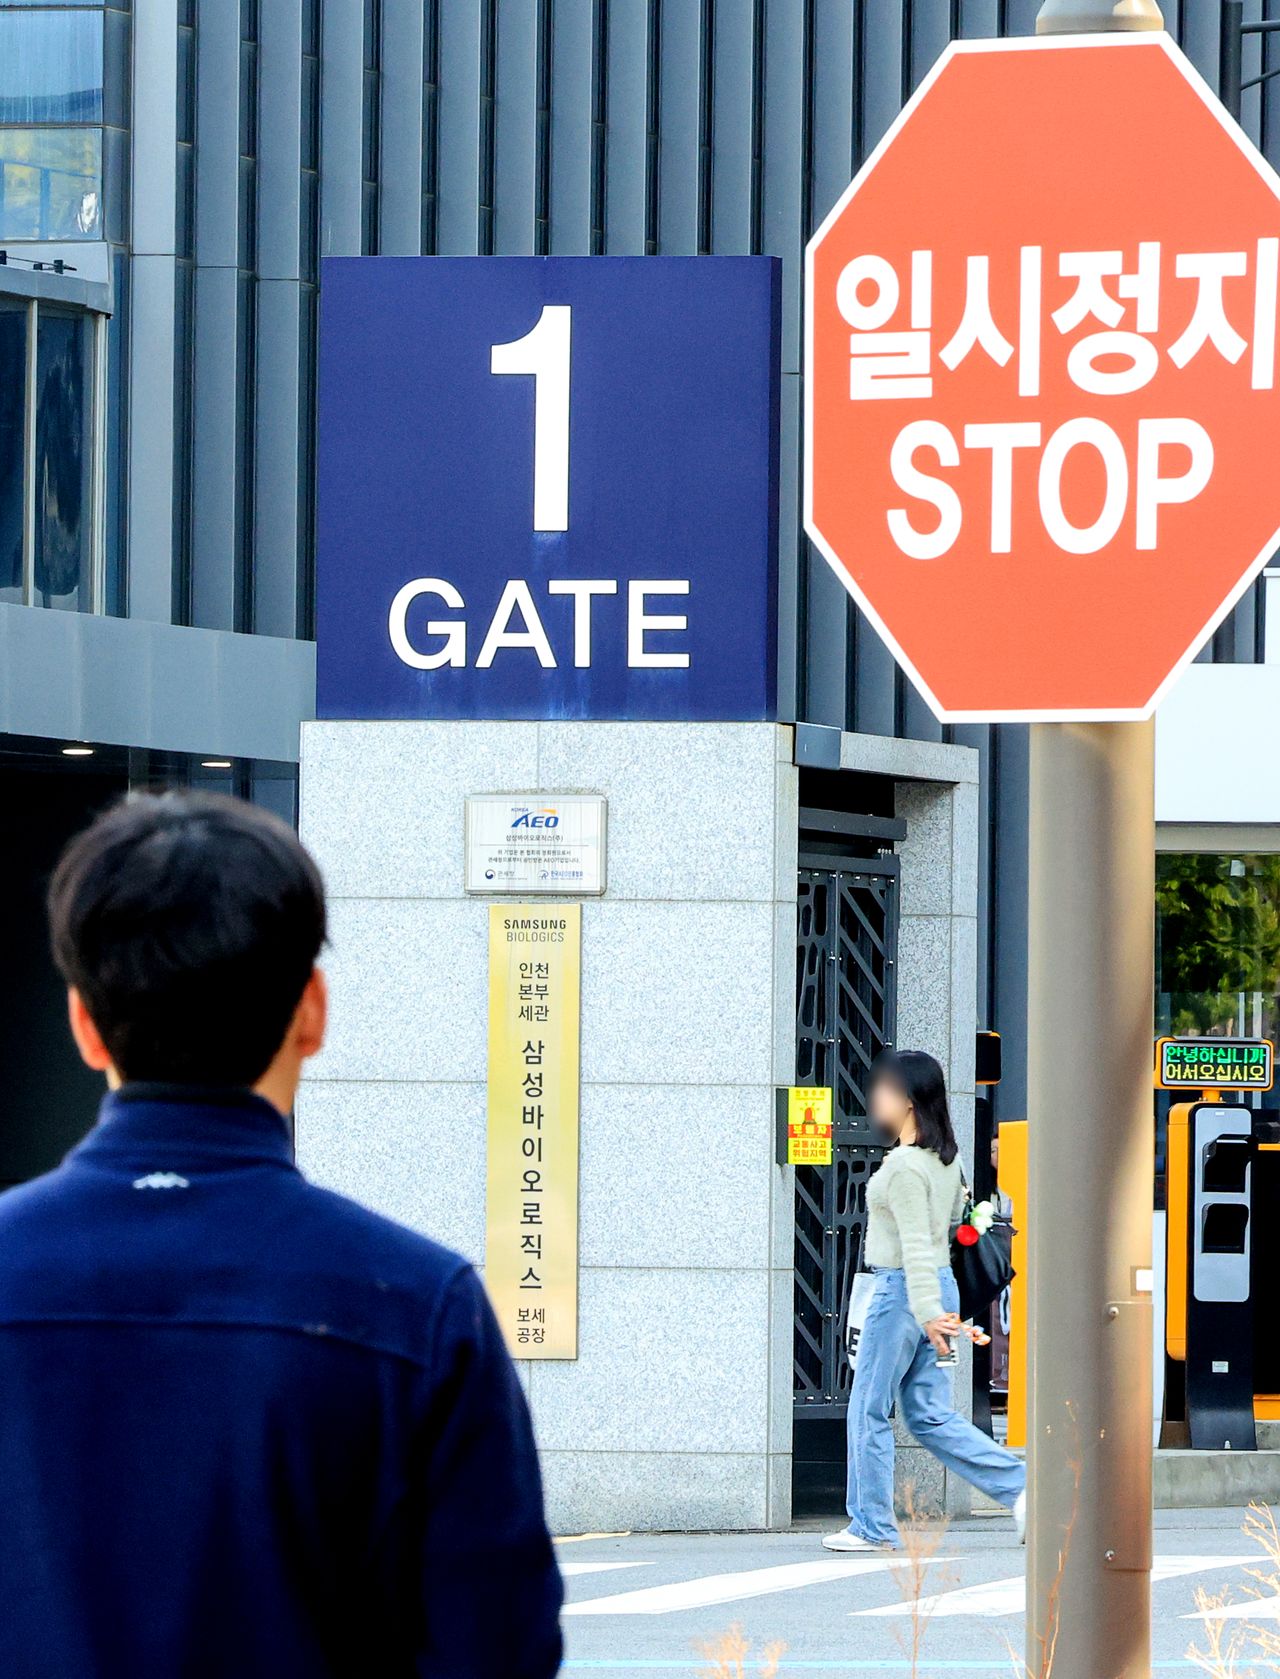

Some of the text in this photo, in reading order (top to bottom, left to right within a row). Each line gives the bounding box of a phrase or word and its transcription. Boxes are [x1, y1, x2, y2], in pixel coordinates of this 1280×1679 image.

[836, 237, 1280, 400] 일시정지
[490, 305, 572, 532] 1
[887, 416, 1214, 560] STOP
[388, 577, 691, 669] GATE
[510, 811, 559, 828] AEO
[504, 919, 567, 930] SAMSUNG
[506, 932, 565, 943] BIOLOGICS
[519, 962, 549, 979] 인천
[518, 984, 549, 1001] 본부
[518, 1005, 549, 1022] 세관
[1166, 1046, 1266, 1064] 안녕하십니까
[1166, 1064, 1265, 1081] 어서오십시오
[793, 1140, 827, 1148] 교통사고
[793, 1149, 827, 1157] 위험지역
[519, 1040, 545, 1289] 삼성바이오로직스
[517, 1308, 546, 1324] 보세
[517, 1327, 546, 1344] 공장
